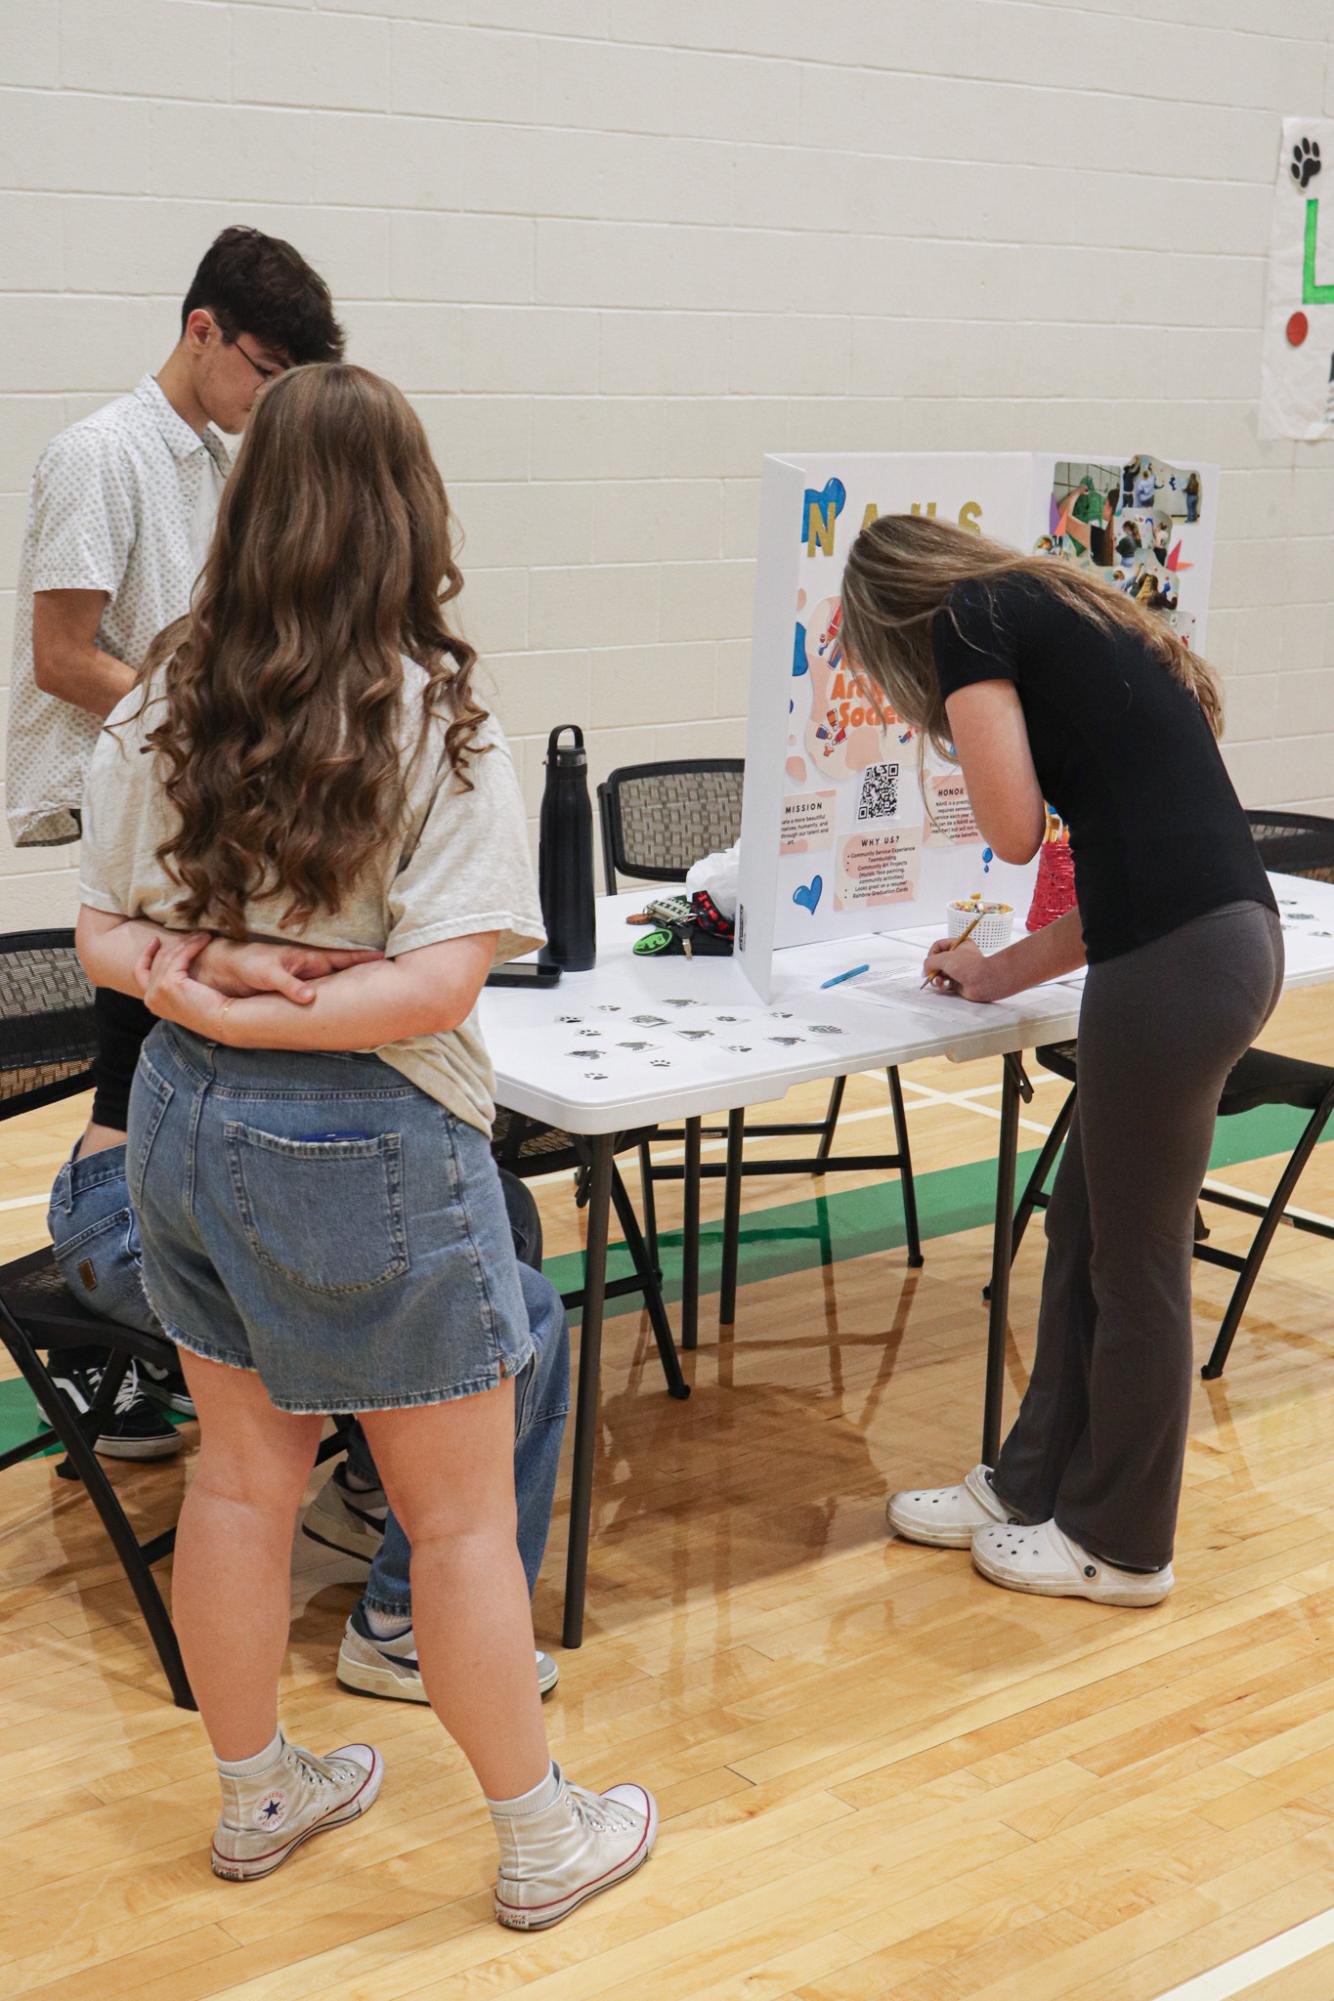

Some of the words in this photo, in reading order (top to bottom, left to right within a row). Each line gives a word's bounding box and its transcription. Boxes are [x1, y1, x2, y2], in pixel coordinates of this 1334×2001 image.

[785, 802, 822, 814] MISSION
[861, 838, 880, 848] WHY
[883, 836, 900, 844] US?
